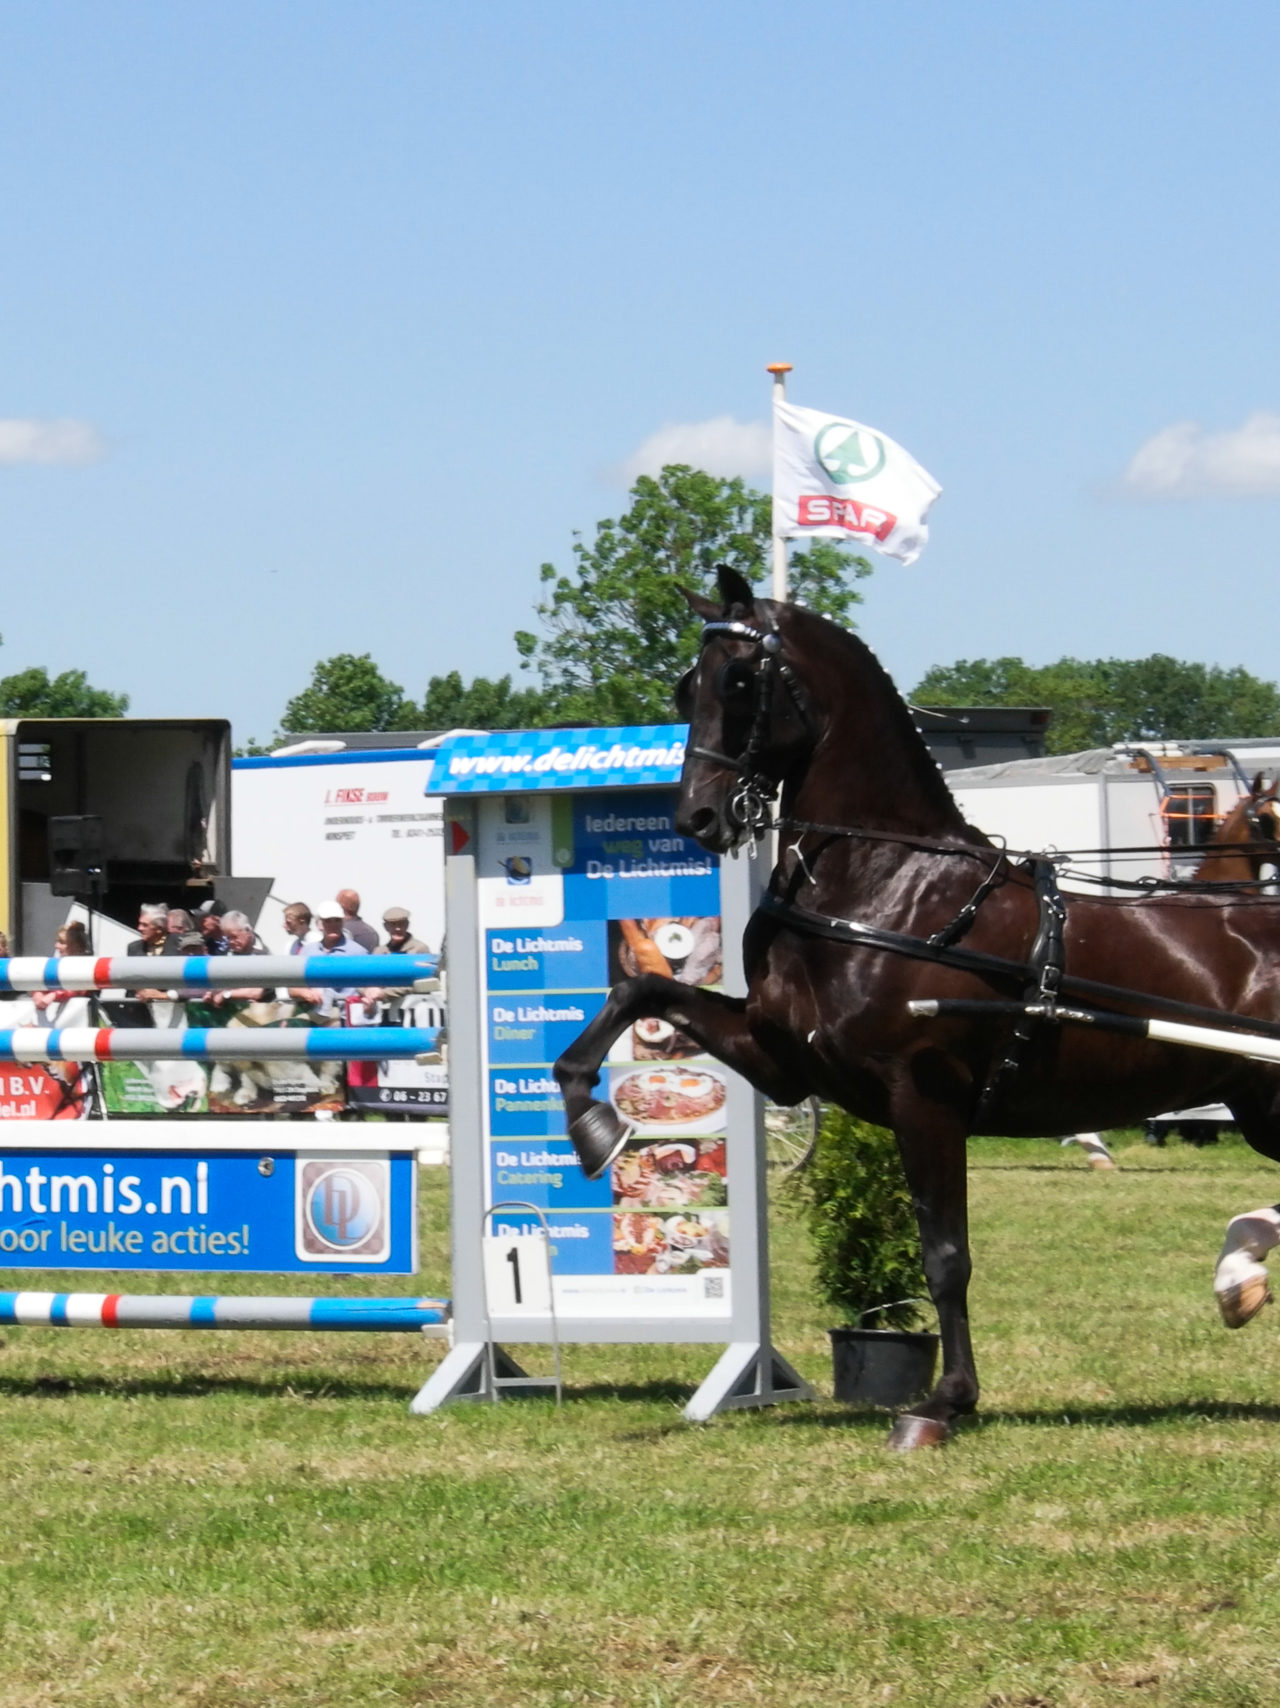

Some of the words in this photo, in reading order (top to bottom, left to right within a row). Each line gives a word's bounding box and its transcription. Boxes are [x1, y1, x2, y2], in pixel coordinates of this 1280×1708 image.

[585, 815, 670, 832] Iedereen
[648, 837, 684, 853] van
[586, 859, 615, 879] De
[618, 856, 713, 878] Lichtmis!
[491, 937, 514, 954] De
[516, 935, 583, 953] Lichtmis
[492, 955, 539, 972] Lunch
[493, 1007, 516, 1023] De
[518, 1006, 585, 1022] Lichtmis
[494, 1025, 537, 1041] Diner
[9, 1076, 50, 1096] B.V.
[494, 1078, 517, 1094] De
[496, 1151, 518, 1167] De
[497, 1170, 563, 1188] Catering
[60, 1220, 143, 1254] leuke
[151, 1224, 250, 1256] acties!
[506, 1247, 522, 1304] 1
